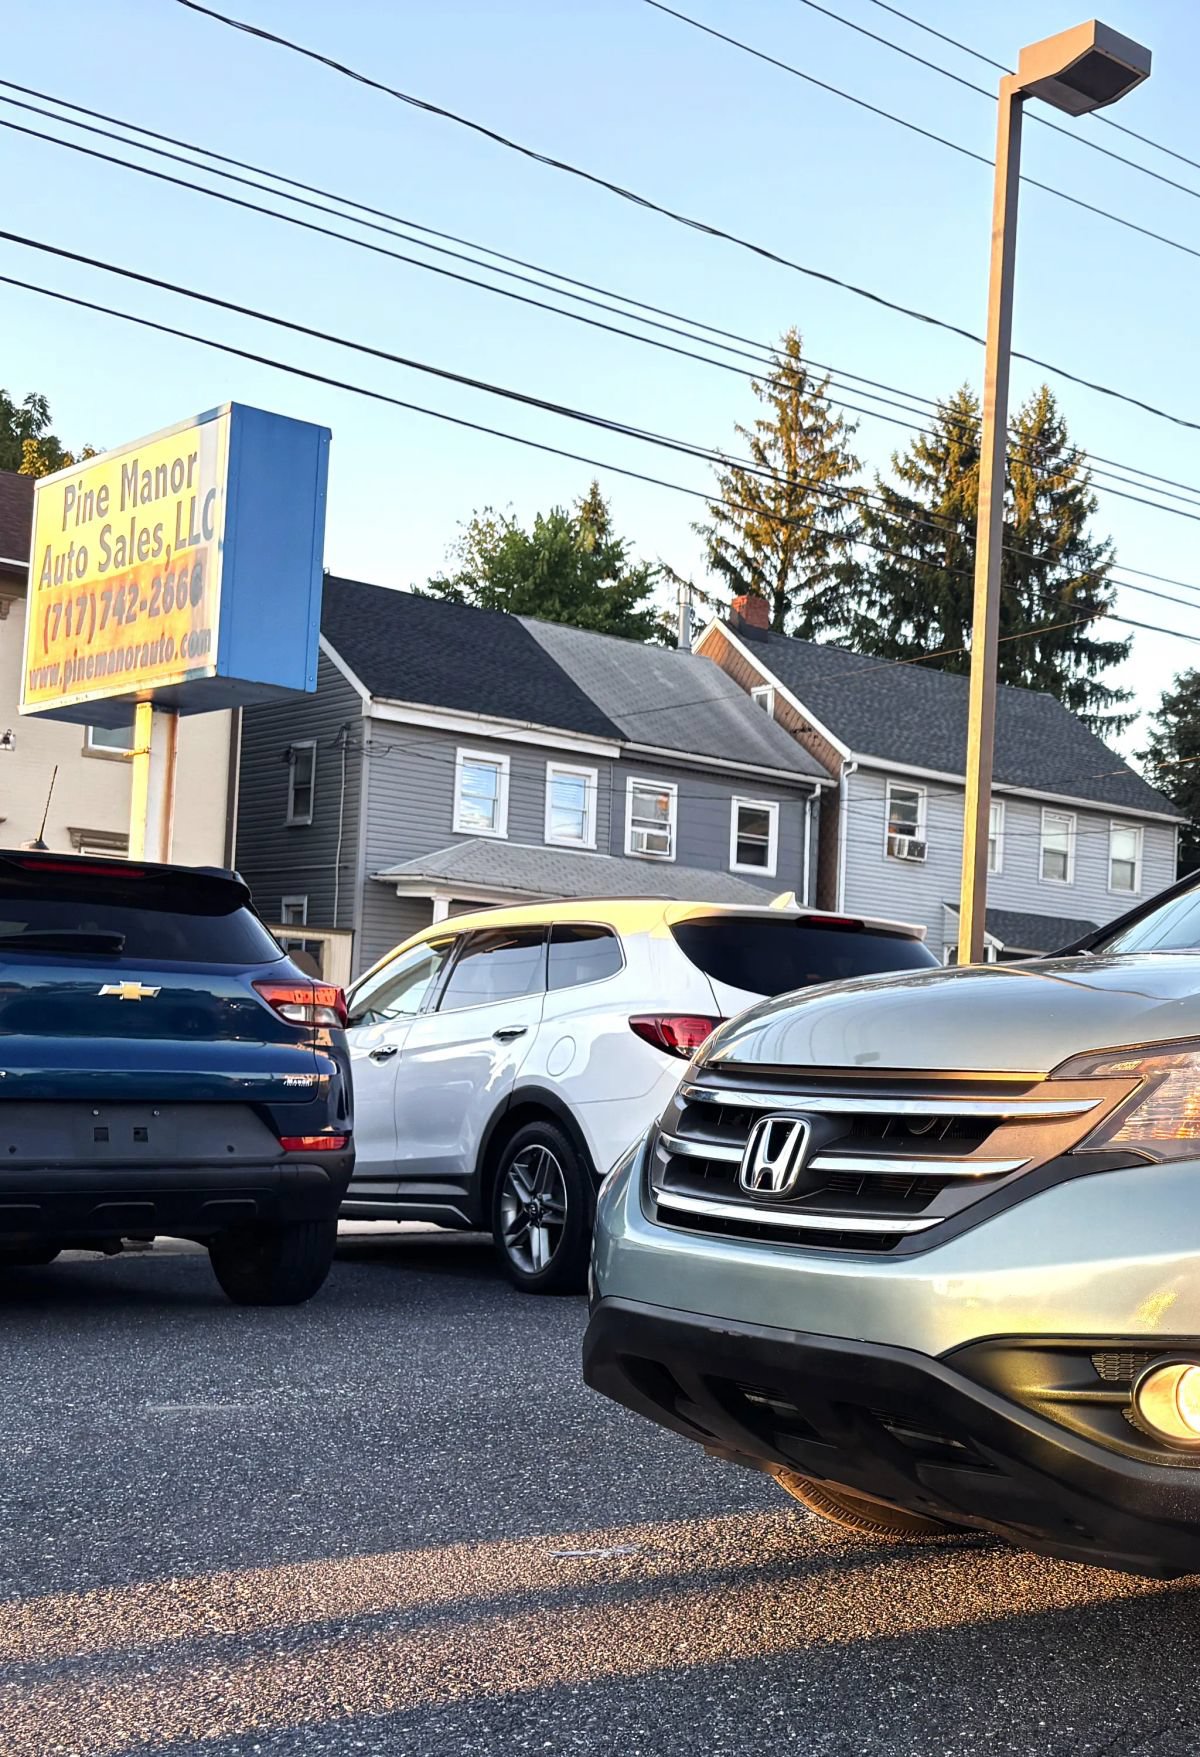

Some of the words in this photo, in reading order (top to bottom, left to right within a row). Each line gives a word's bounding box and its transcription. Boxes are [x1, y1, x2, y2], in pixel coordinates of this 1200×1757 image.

[62, 480, 109, 531] Pine
[121, 451, 198, 511] Manor
[39, 541, 88, 590] Auto
[29, 628, 211, 693] www.pinemanorauto.com
